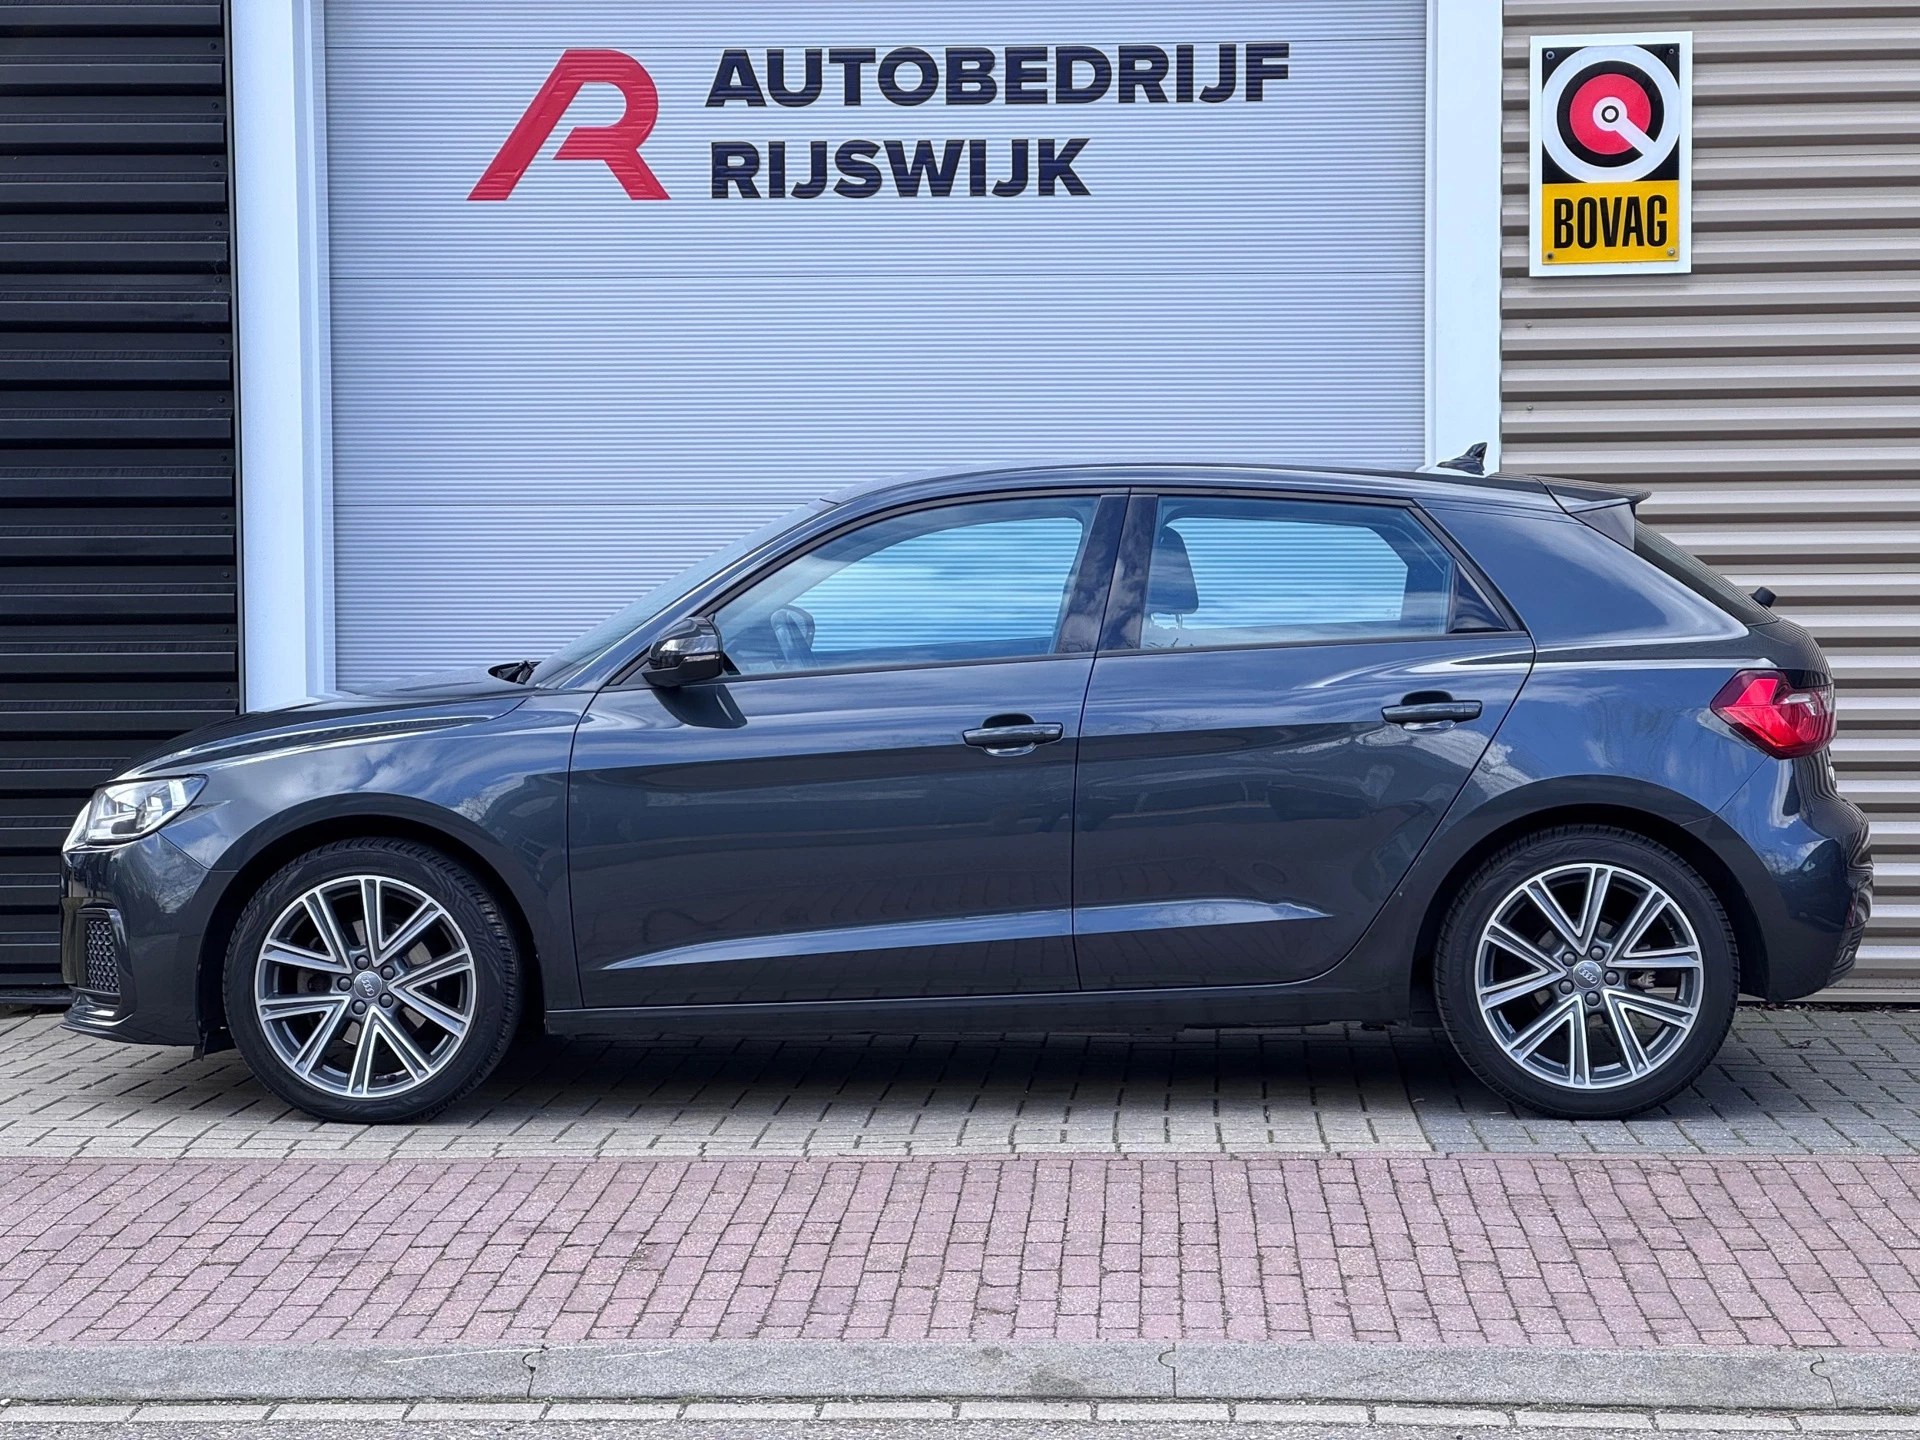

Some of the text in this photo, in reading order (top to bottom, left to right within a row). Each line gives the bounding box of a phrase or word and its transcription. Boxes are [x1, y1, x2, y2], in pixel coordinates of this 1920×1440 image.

[705, 43, 1290, 108] AUTOBEDRIJF
[711, 138, 1091, 200] RIJSWIJK
[1553, 195, 1668, 249] BOVAG
